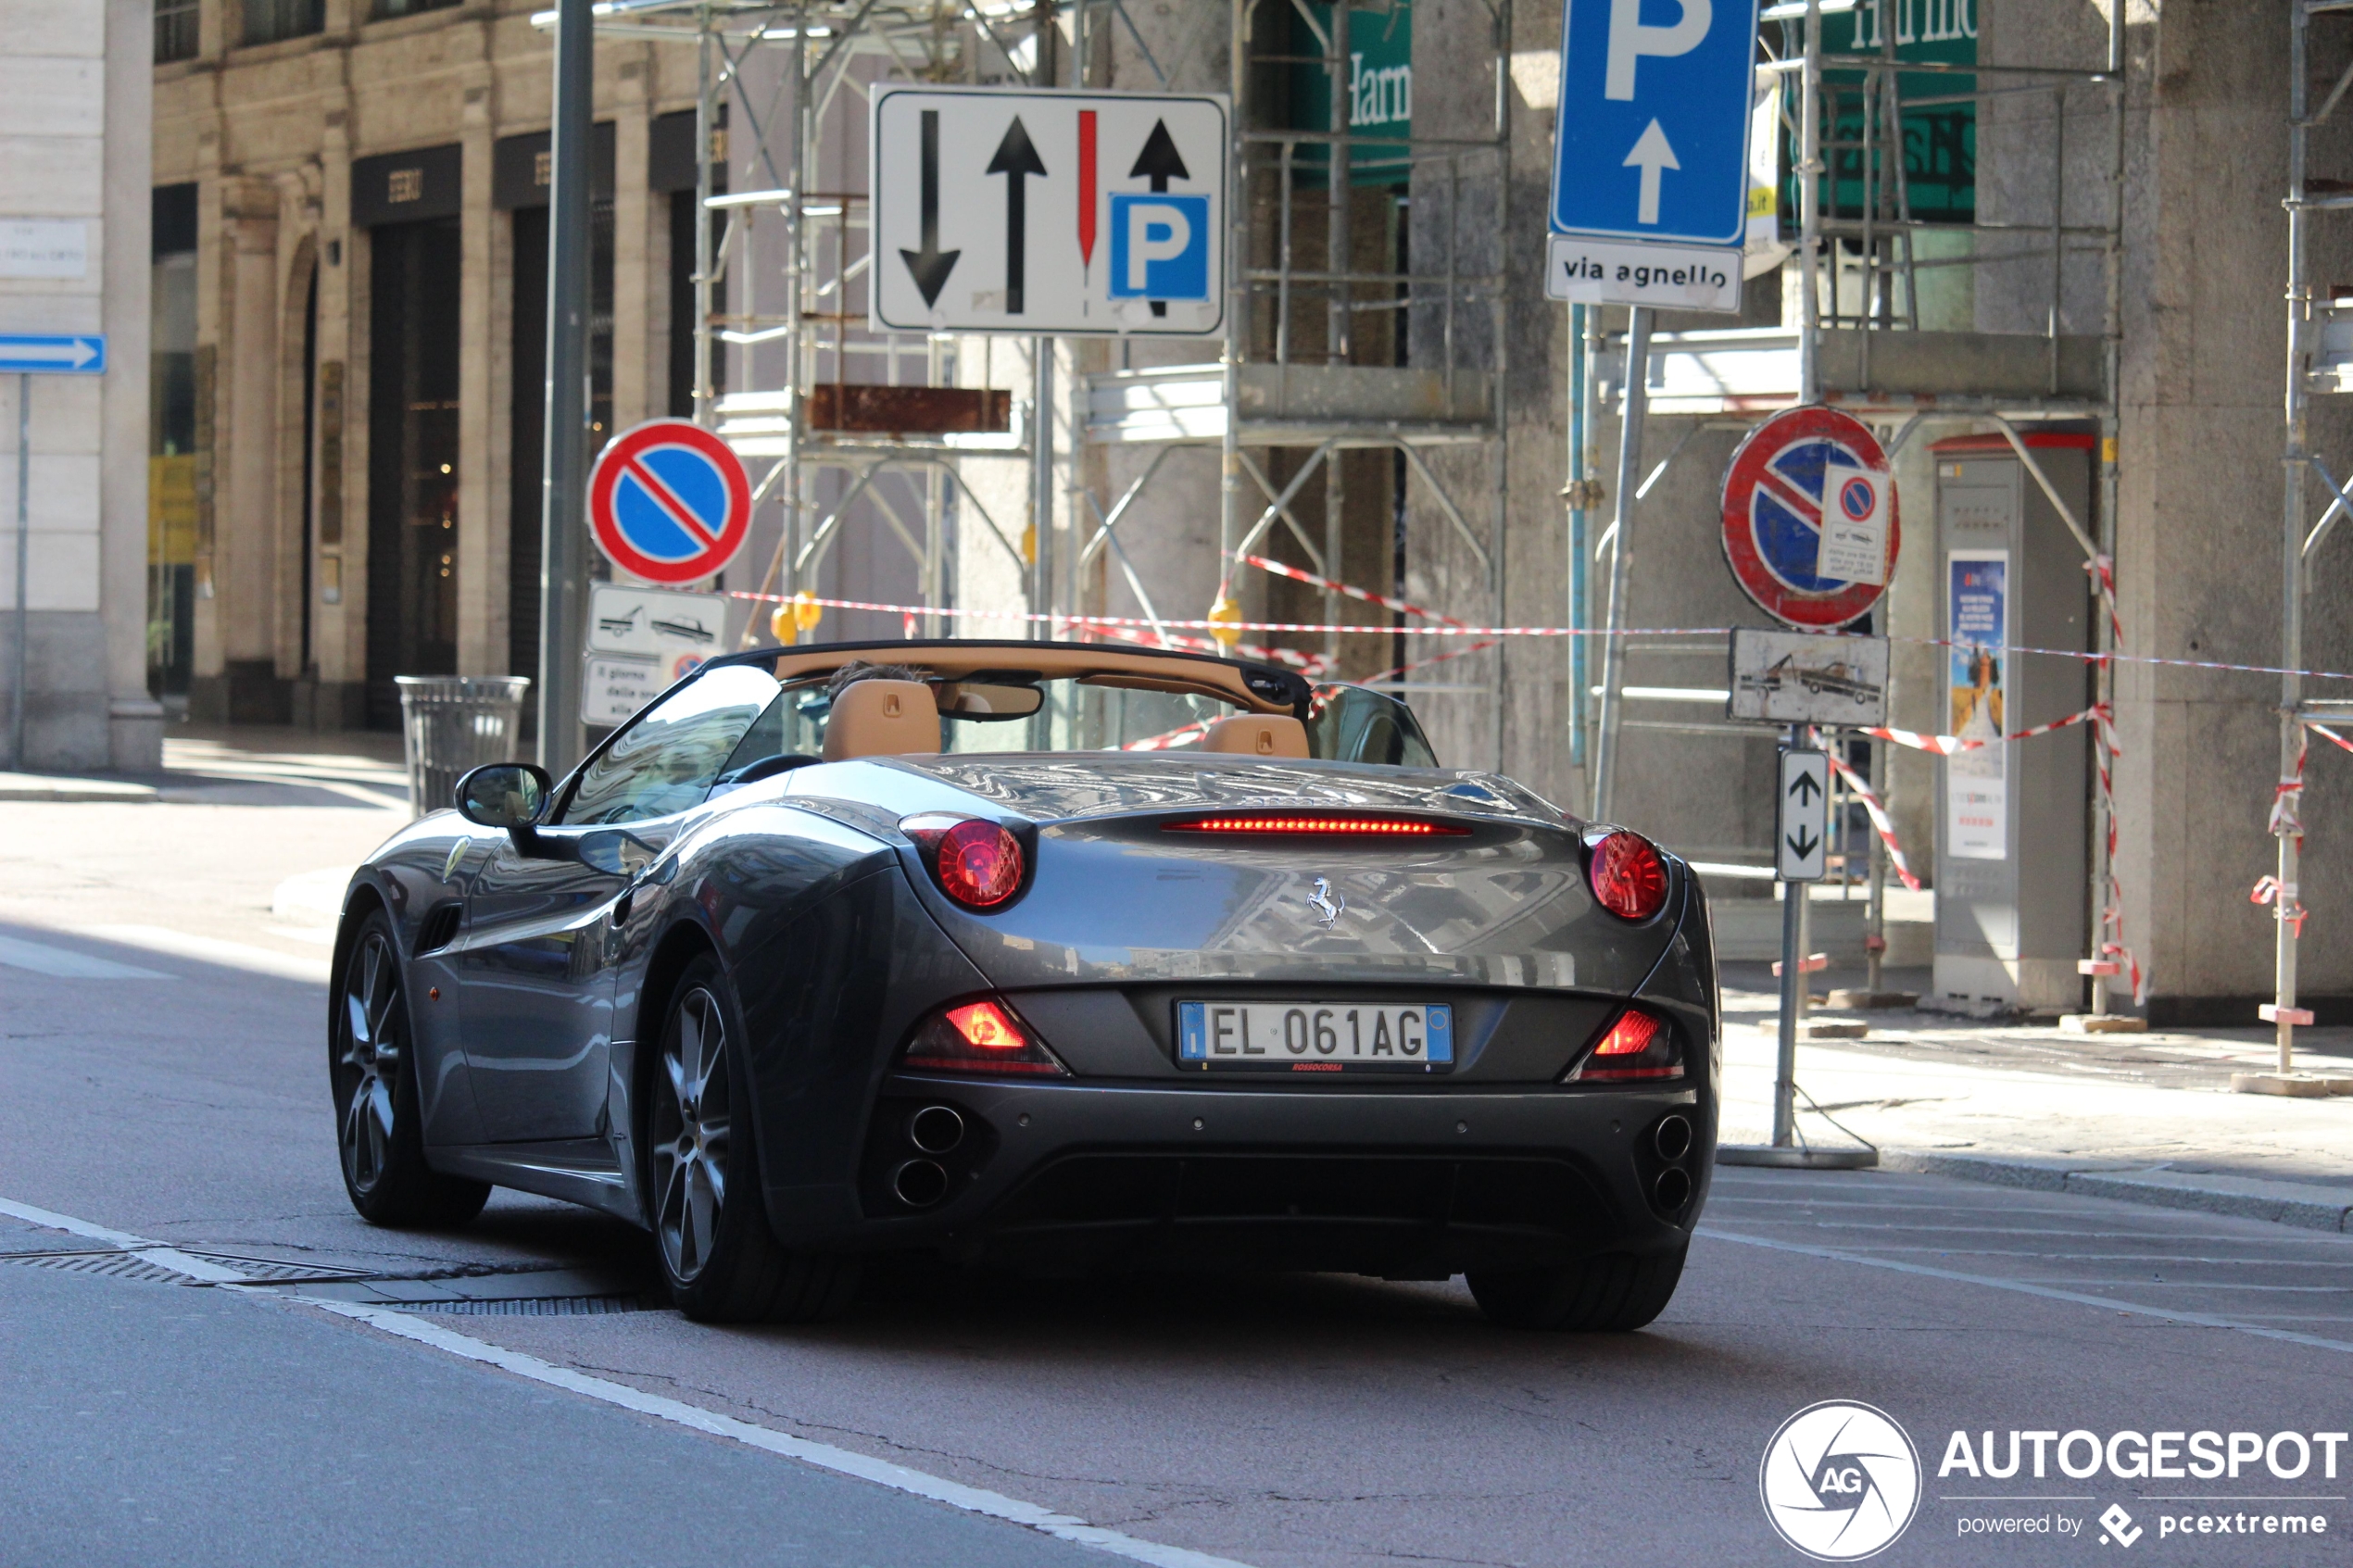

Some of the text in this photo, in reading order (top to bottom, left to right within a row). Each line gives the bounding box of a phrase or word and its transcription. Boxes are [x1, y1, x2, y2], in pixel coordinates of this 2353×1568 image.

[1604, 0, 1712, 102] P
[1127, 204, 1191, 290] P
[1564, 257, 1727, 289] via agnello
[609, 668, 646, 681] giorno
[1211, 1008, 1265, 1055] EL
[1283, 1009, 1422, 1056] 061AG
[1291, 1063, 1342, 1072] ROSSOCORSA
